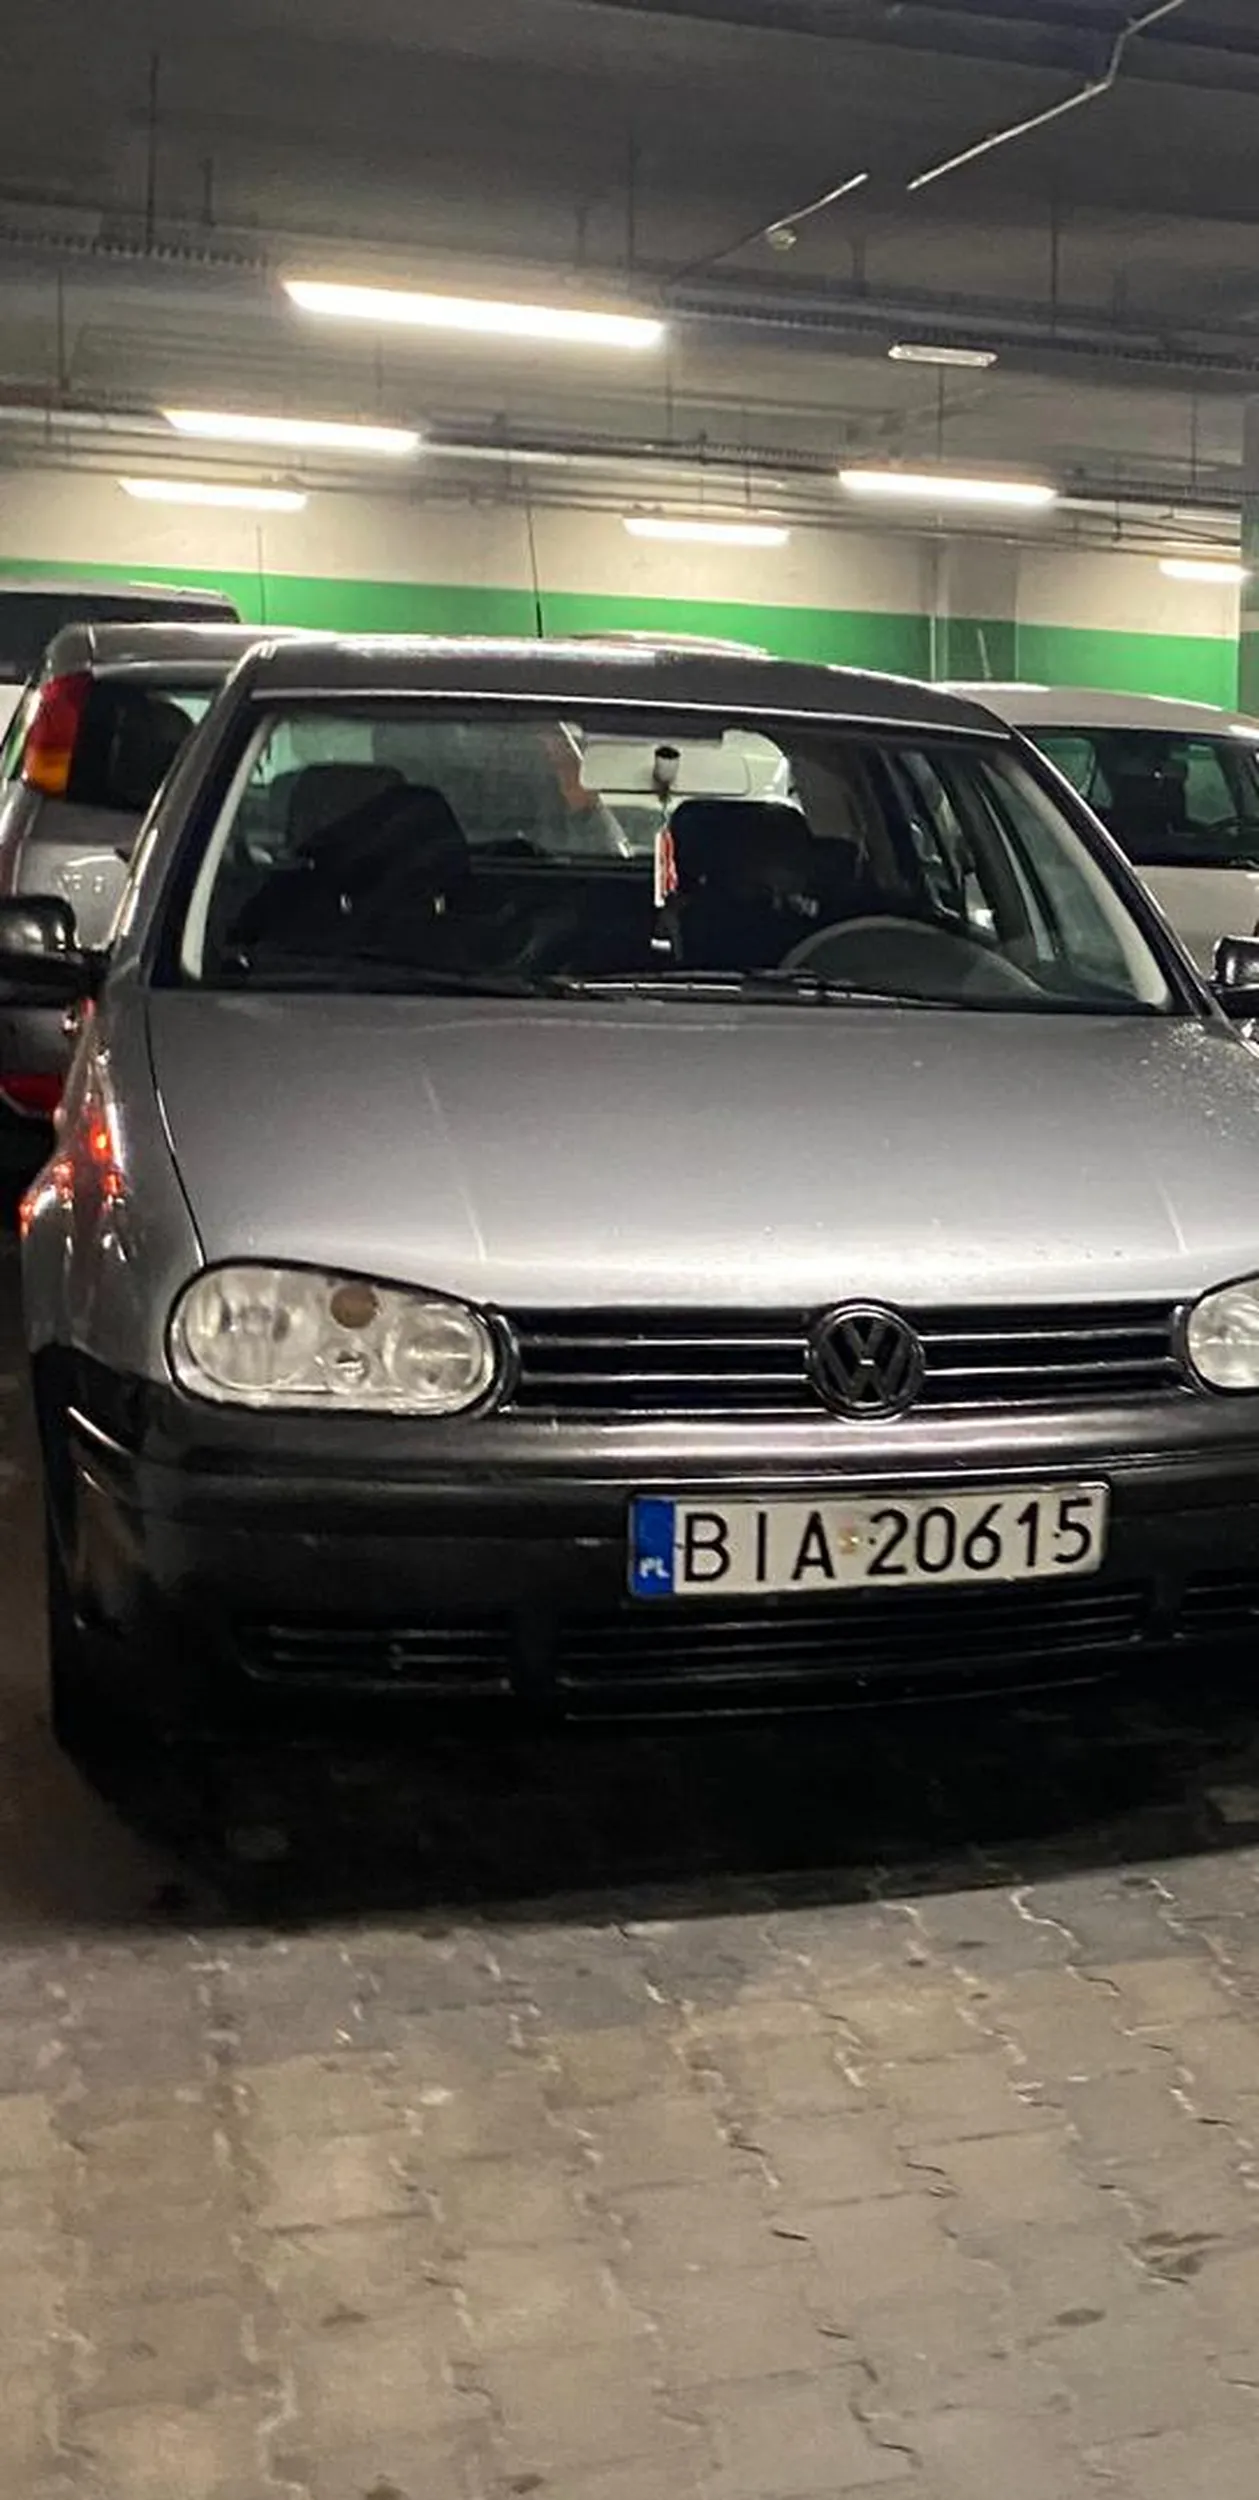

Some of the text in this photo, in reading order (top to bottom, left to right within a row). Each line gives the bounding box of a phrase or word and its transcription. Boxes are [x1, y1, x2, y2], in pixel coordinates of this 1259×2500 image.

[814, 1312, 914, 1406] VW
[639, 1557, 669, 1578] PL
[683, 1497, 1093, 1582] BIA 20615
